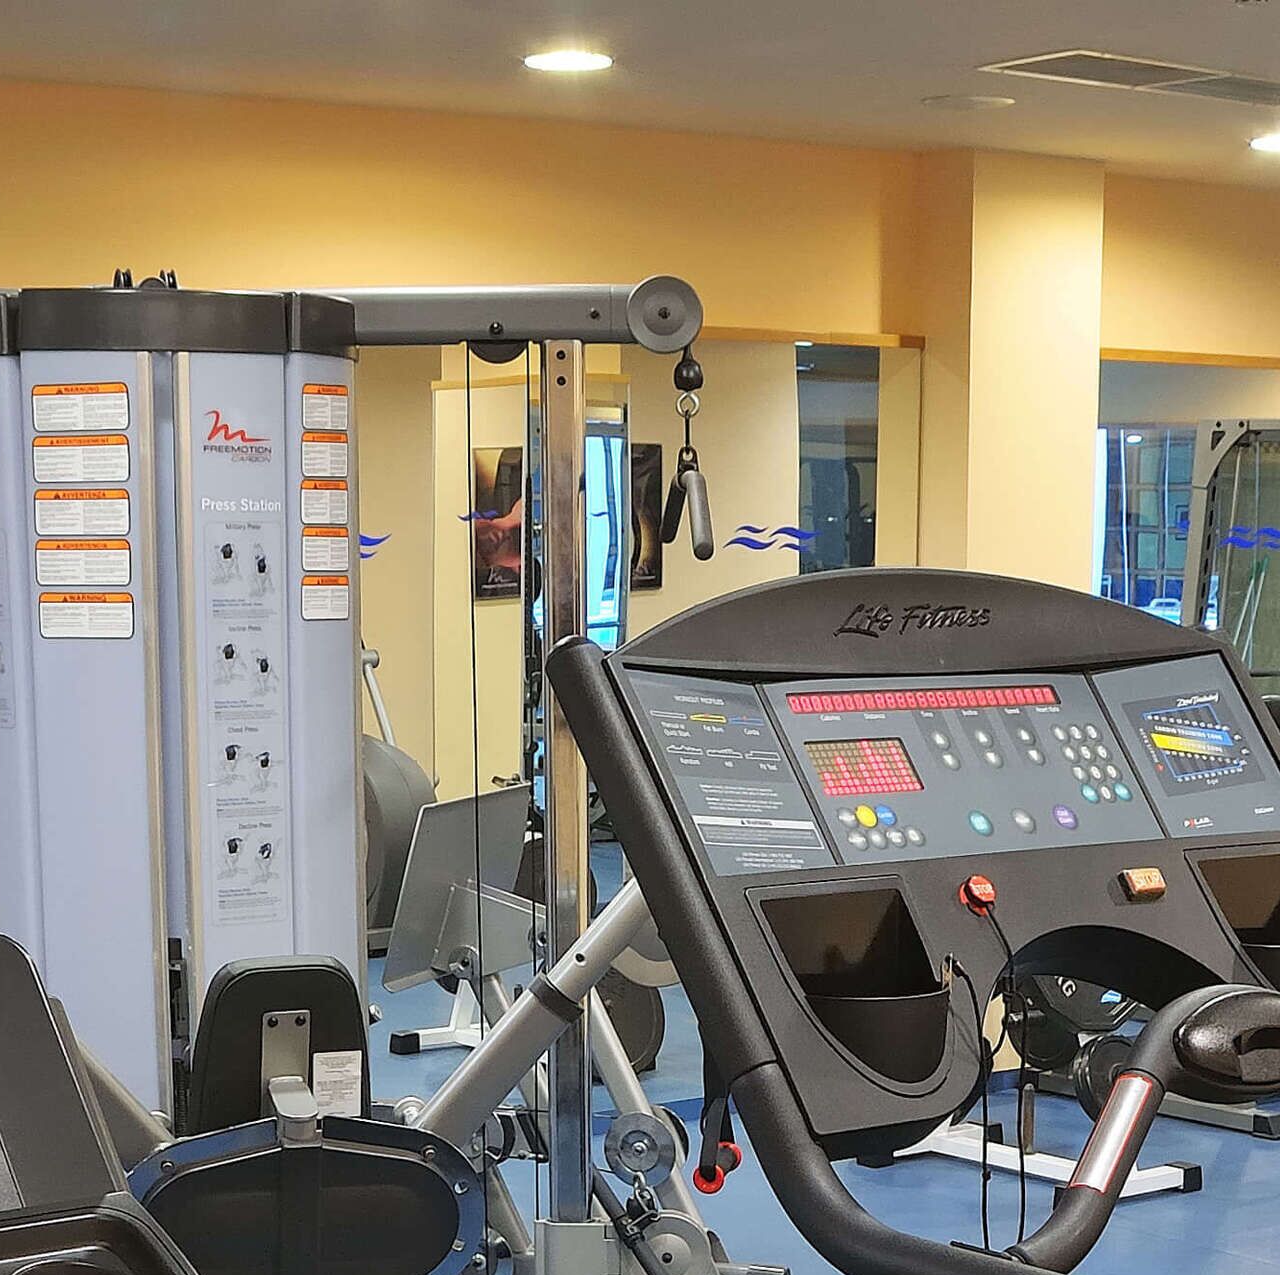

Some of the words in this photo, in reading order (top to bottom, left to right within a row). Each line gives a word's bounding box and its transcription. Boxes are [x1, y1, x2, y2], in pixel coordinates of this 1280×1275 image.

[203, 444, 272, 454] FREEMOTION
[201, 498, 237, 511] Press
[240, 498, 281, 511] Station
[833, 603, 893, 639] Life
[898, 603, 991, 636] Fitness
